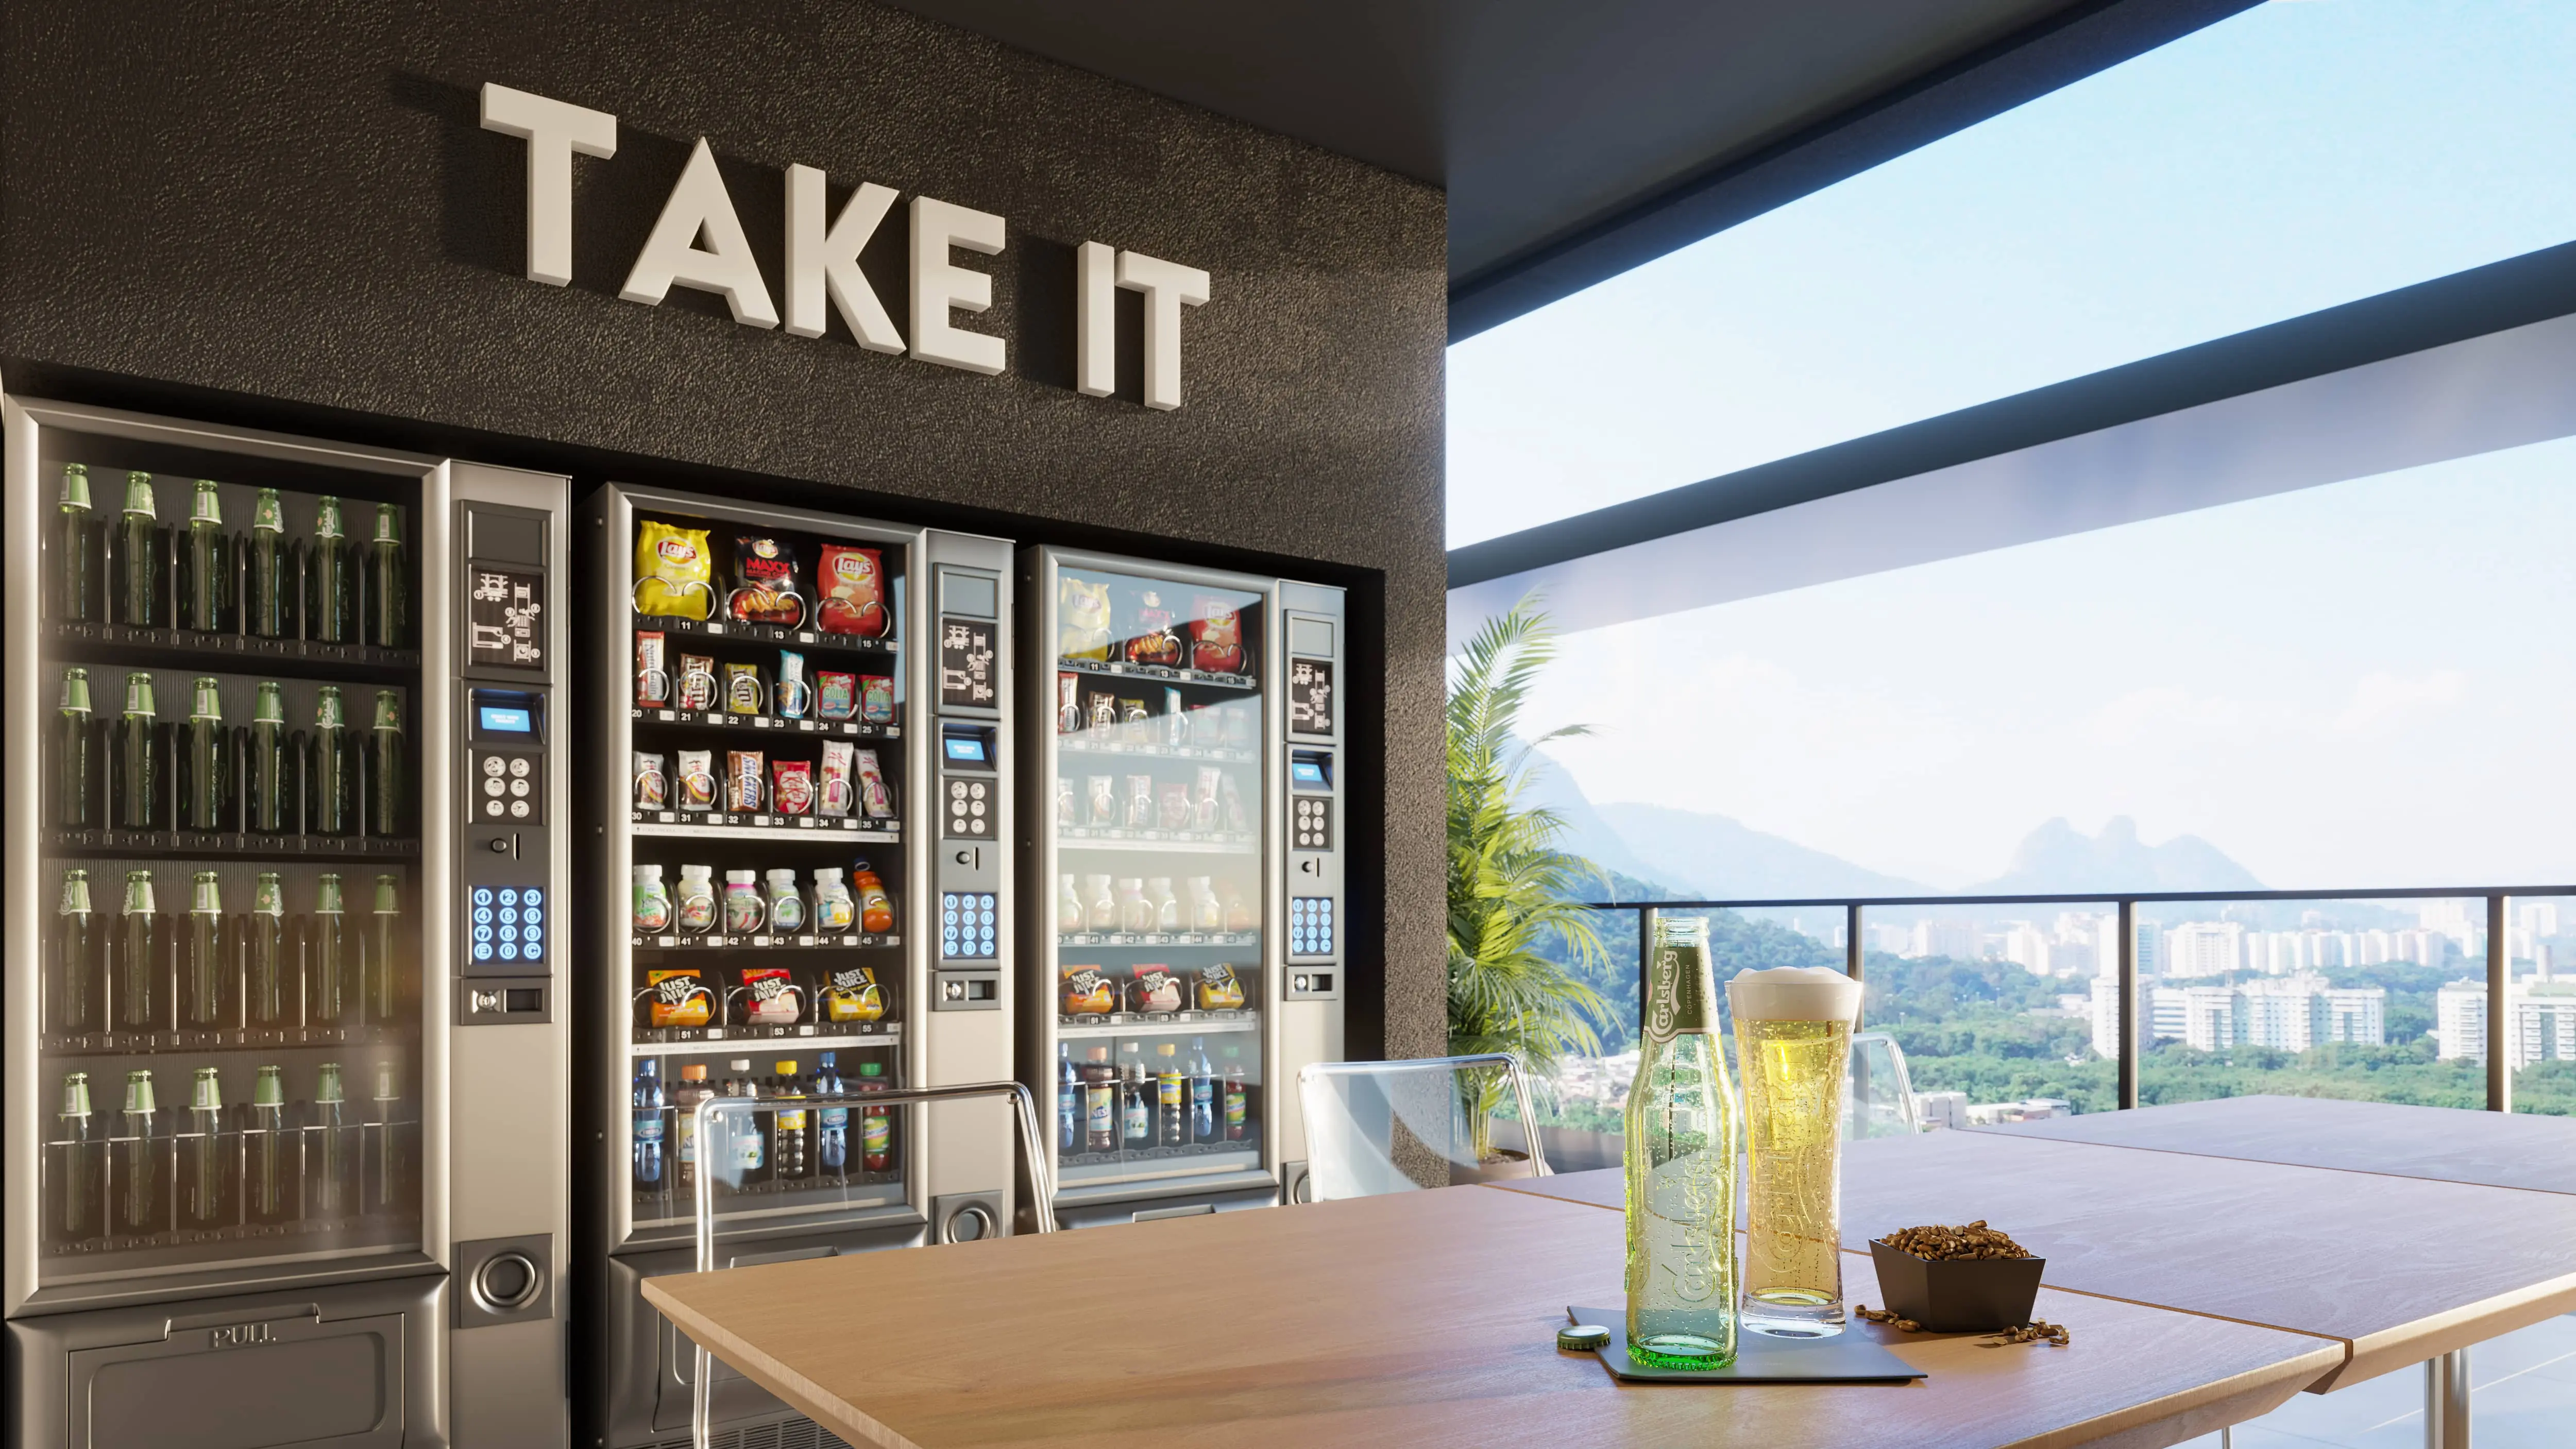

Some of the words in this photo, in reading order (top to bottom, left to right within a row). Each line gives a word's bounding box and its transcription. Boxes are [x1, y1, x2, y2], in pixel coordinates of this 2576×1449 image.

[480, 81, 1006, 376] TAKE
[1077, 240, 1210, 411] IT
[746, 557, 790, 573] MAXX
[632, 937, 642, 946] 40
[659, 976, 690, 991] JUST
[753, 977, 782, 991] JUST
[834, 968, 860, 984] JUST
[1651, 950, 1681, 1035] Carlsberg
[681, 1031, 691, 1039] 51
[213, 1323, 277, 1348] PULL
